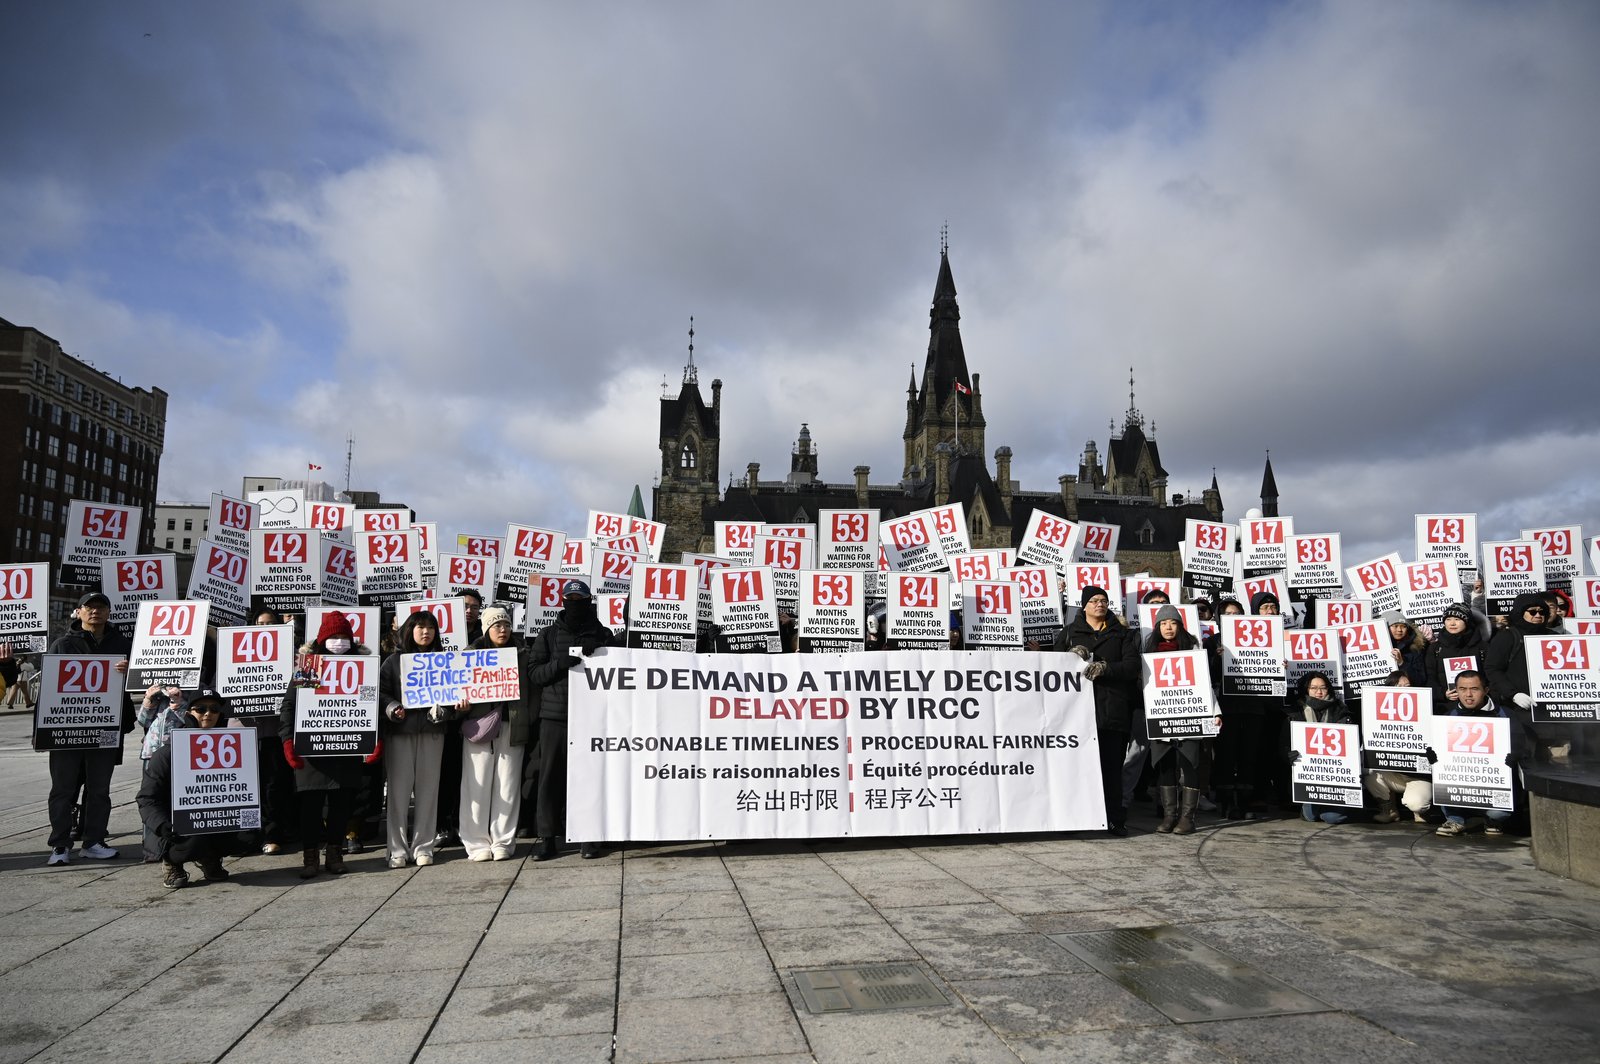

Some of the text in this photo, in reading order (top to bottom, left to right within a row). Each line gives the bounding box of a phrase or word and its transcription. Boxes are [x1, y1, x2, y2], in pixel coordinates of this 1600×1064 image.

[87, 508, 122, 538] 54
[224, 502, 247, 529] 19
[315, 506, 339, 530] 19
[598, 515, 618, 536] 25
[836, 514, 864, 541] 53
[729, 526, 753, 548] 34
[896, 520, 924, 548] 68
[1040, 518, 1066, 545] 33
[1087, 527, 1109, 549] 27
[1199, 525, 1223, 550] 33
[1256, 522, 1277, 544] 17
[1431, 520, 1460, 543] 43
[1540, 532, 1568, 556] 29
[269, 534, 302, 562] 42
[373, 535, 404, 563] 32
[519, 532, 549, 560] 42
[770, 541, 796, 569] 15
[1300, 539, 1327, 562] 38
[211, 549, 243, 582] 20
[453, 559, 482, 585] 39
[606, 554, 632, 579] 22
[961, 557, 988, 580] 55
[1500, 547, 1529, 572] 65
[123, 561, 159, 591] 36
[650, 569, 679, 599] 11
[728, 572, 758, 601] 71
[1015, 571, 1043, 598] 68
[1080, 567, 1106, 588] 34
[1362, 561, 1393, 589] 30
[1413, 564, 1445, 589] 55
[817, 576, 848, 605] 53
[904, 577, 934, 606] 34
[981, 586, 1007, 613] 51
[648, 603, 680, 611] MONTHS
[1331, 604, 1358, 626] 30
[153, 605, 192, 635] 20
[652, 621, 692, 630] RESPONSE
[821, 627, 860, 635] RESPONSE
[1239, 620, 1268, 647] 33
[1345, 625, 1375, 652] 24
[237, 632, 273, 661] 40
[1295, 634, 1324, 660] 46
[1546, 640, 1584, 668] 34
[237, 665, 274, 674] MONTHS
[413, 650, 498, 671] STOP THE
[1159, 657, 1190, 686] 41
[1454, 661, 1468, 670] 24
[63, 661, 104, 692] 20
[228, 675, 264, 684] WAITING
[242, 683, 288, 691] RESPONSE
[322, 661, 359, 694] 40
[585, 668, 1082, 693] WE DEMAND A TIMELY DECISION
[1161, 689, 1193, 697] MONTHS
[709, 696, 980, 719] DELAYED BY IRCC
[1168, 706, 1208, 714] RESPONSE
[1380, 693, 1413, 721] 40
[324, 719, 371, 727] RESPONSE
[591, 736, 839, 752] REASONABLE TIMELINES
[862, 734, 1079, 750] PROCEDURAL FAIRNESS
[1309, 728, 1341, 755] 43
[1386, 741, 1428, 749] RESPONSE
[1452, 723, 1489, 752] 22
[196, 734, 236, 768] 36
[196, 773, 237, 783] MONTHS
[644, 764, 840, 779] Délais raisonnables
[863, 759, 1035, 780] Équité procédurale
[179, 793, 253, 806] IRCC RESPONSE
[185, 783, 247, 794] WAITING FOR
[736, 789, 839, 812] 给出时限
[865, 787, 962, 810] 程序公平
